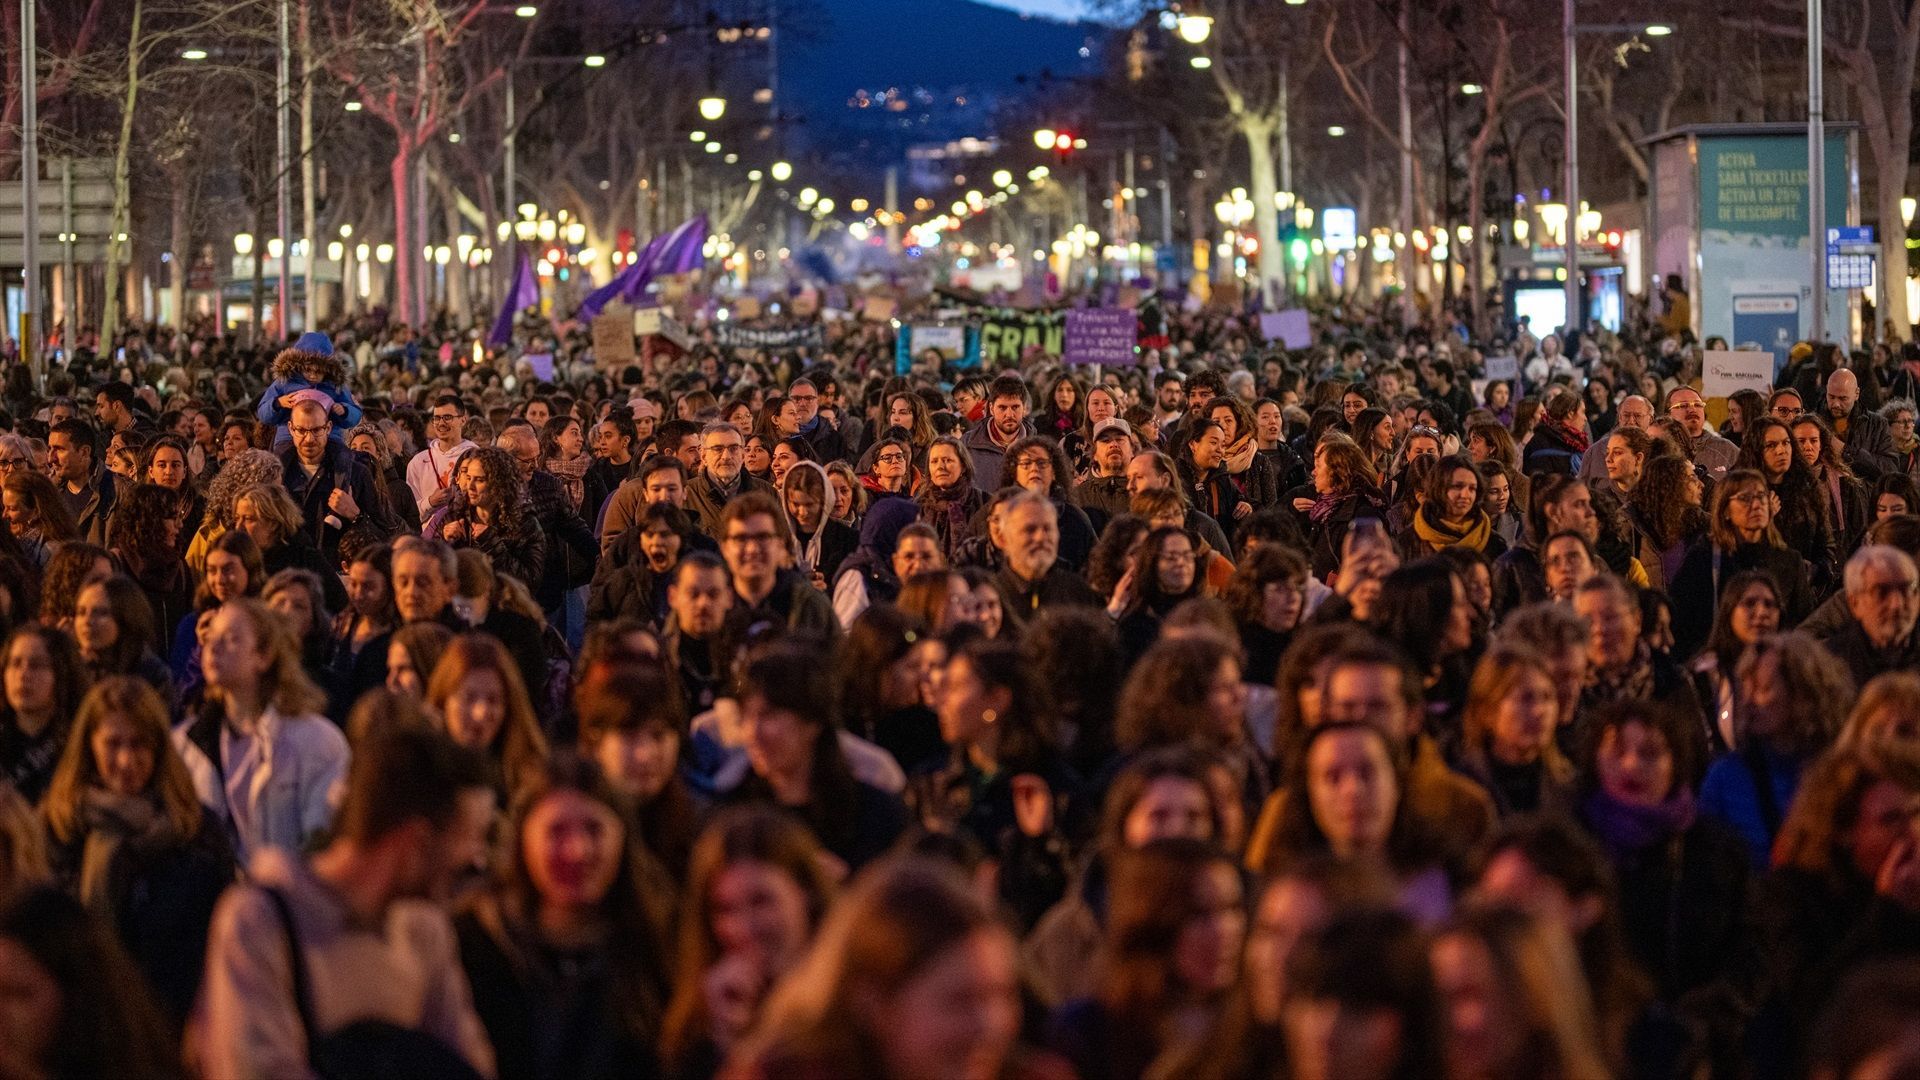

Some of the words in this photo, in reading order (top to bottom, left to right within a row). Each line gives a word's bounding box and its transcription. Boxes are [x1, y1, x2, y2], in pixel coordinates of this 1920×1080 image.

[1718, 154, 1755, 168] ACTIVA
[1718, 188, 1756, 203] ACTIVA
[1828, 229, 1840, 245] P
